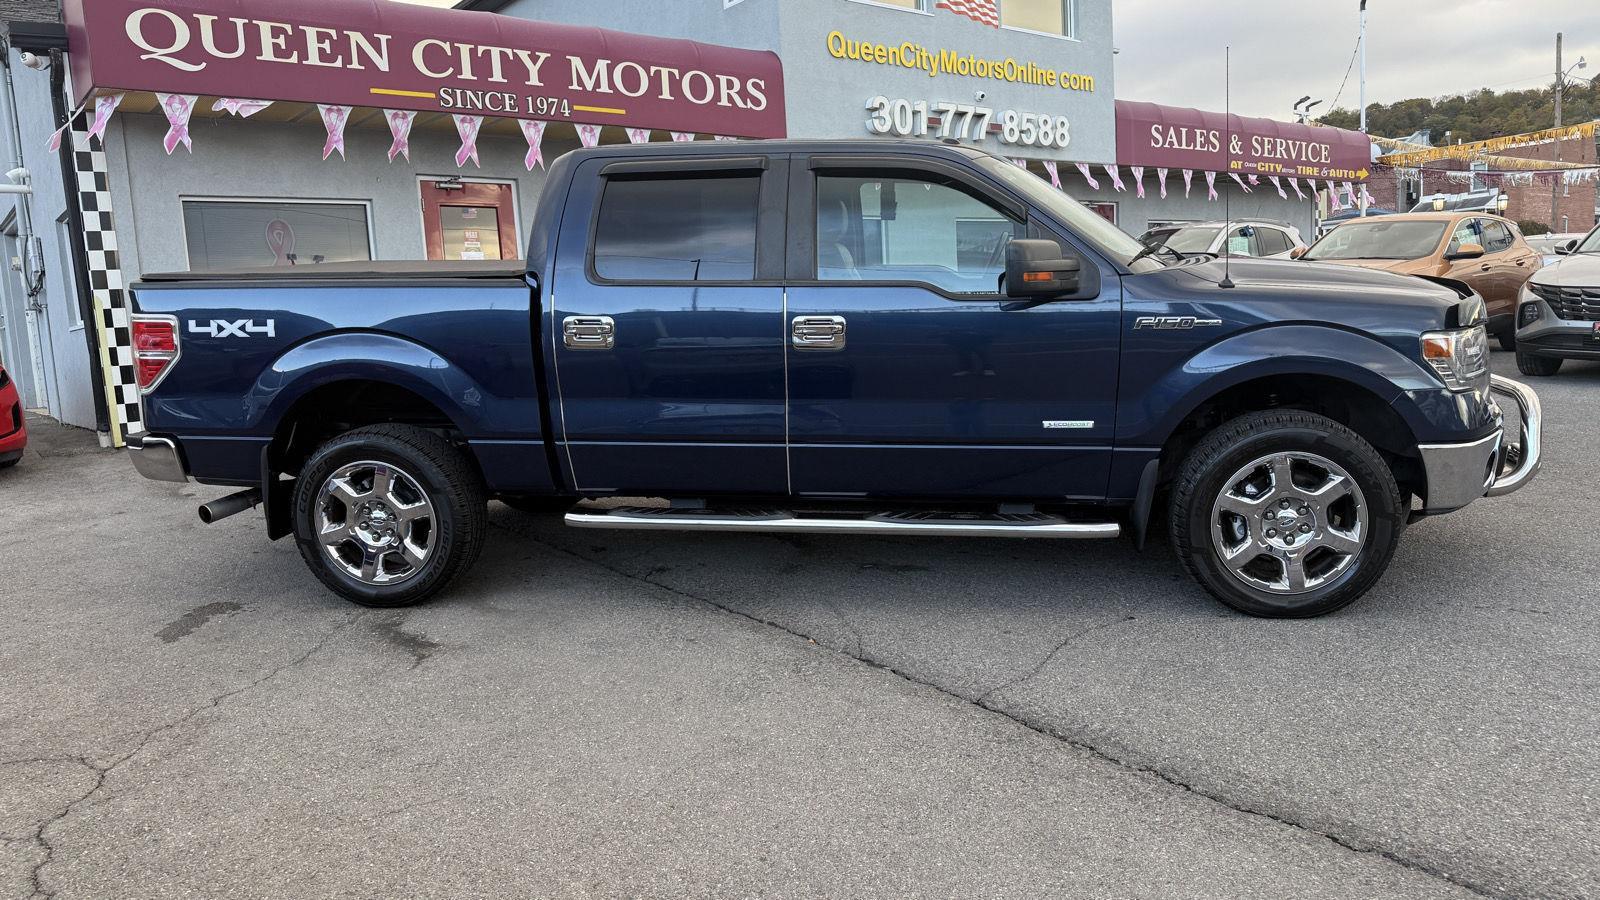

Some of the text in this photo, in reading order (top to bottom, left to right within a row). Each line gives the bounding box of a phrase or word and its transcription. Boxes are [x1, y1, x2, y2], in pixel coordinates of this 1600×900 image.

[125, 8, 767, 111] QUEEN CITY MOTORS
[827, 30, 1057, 86] QueenCityMotorsOnline
[438, 86, 572, 118] SINCE 1974
[1150, 124, 1332, 164] SALES & SERVICE
[1230, 160, 1243, 170] AT
[1257, 162, 1283, 173] CITY
[1296, 165, 1320, 176] TIRE
[1329, 168, 1356, 179] AUTO
